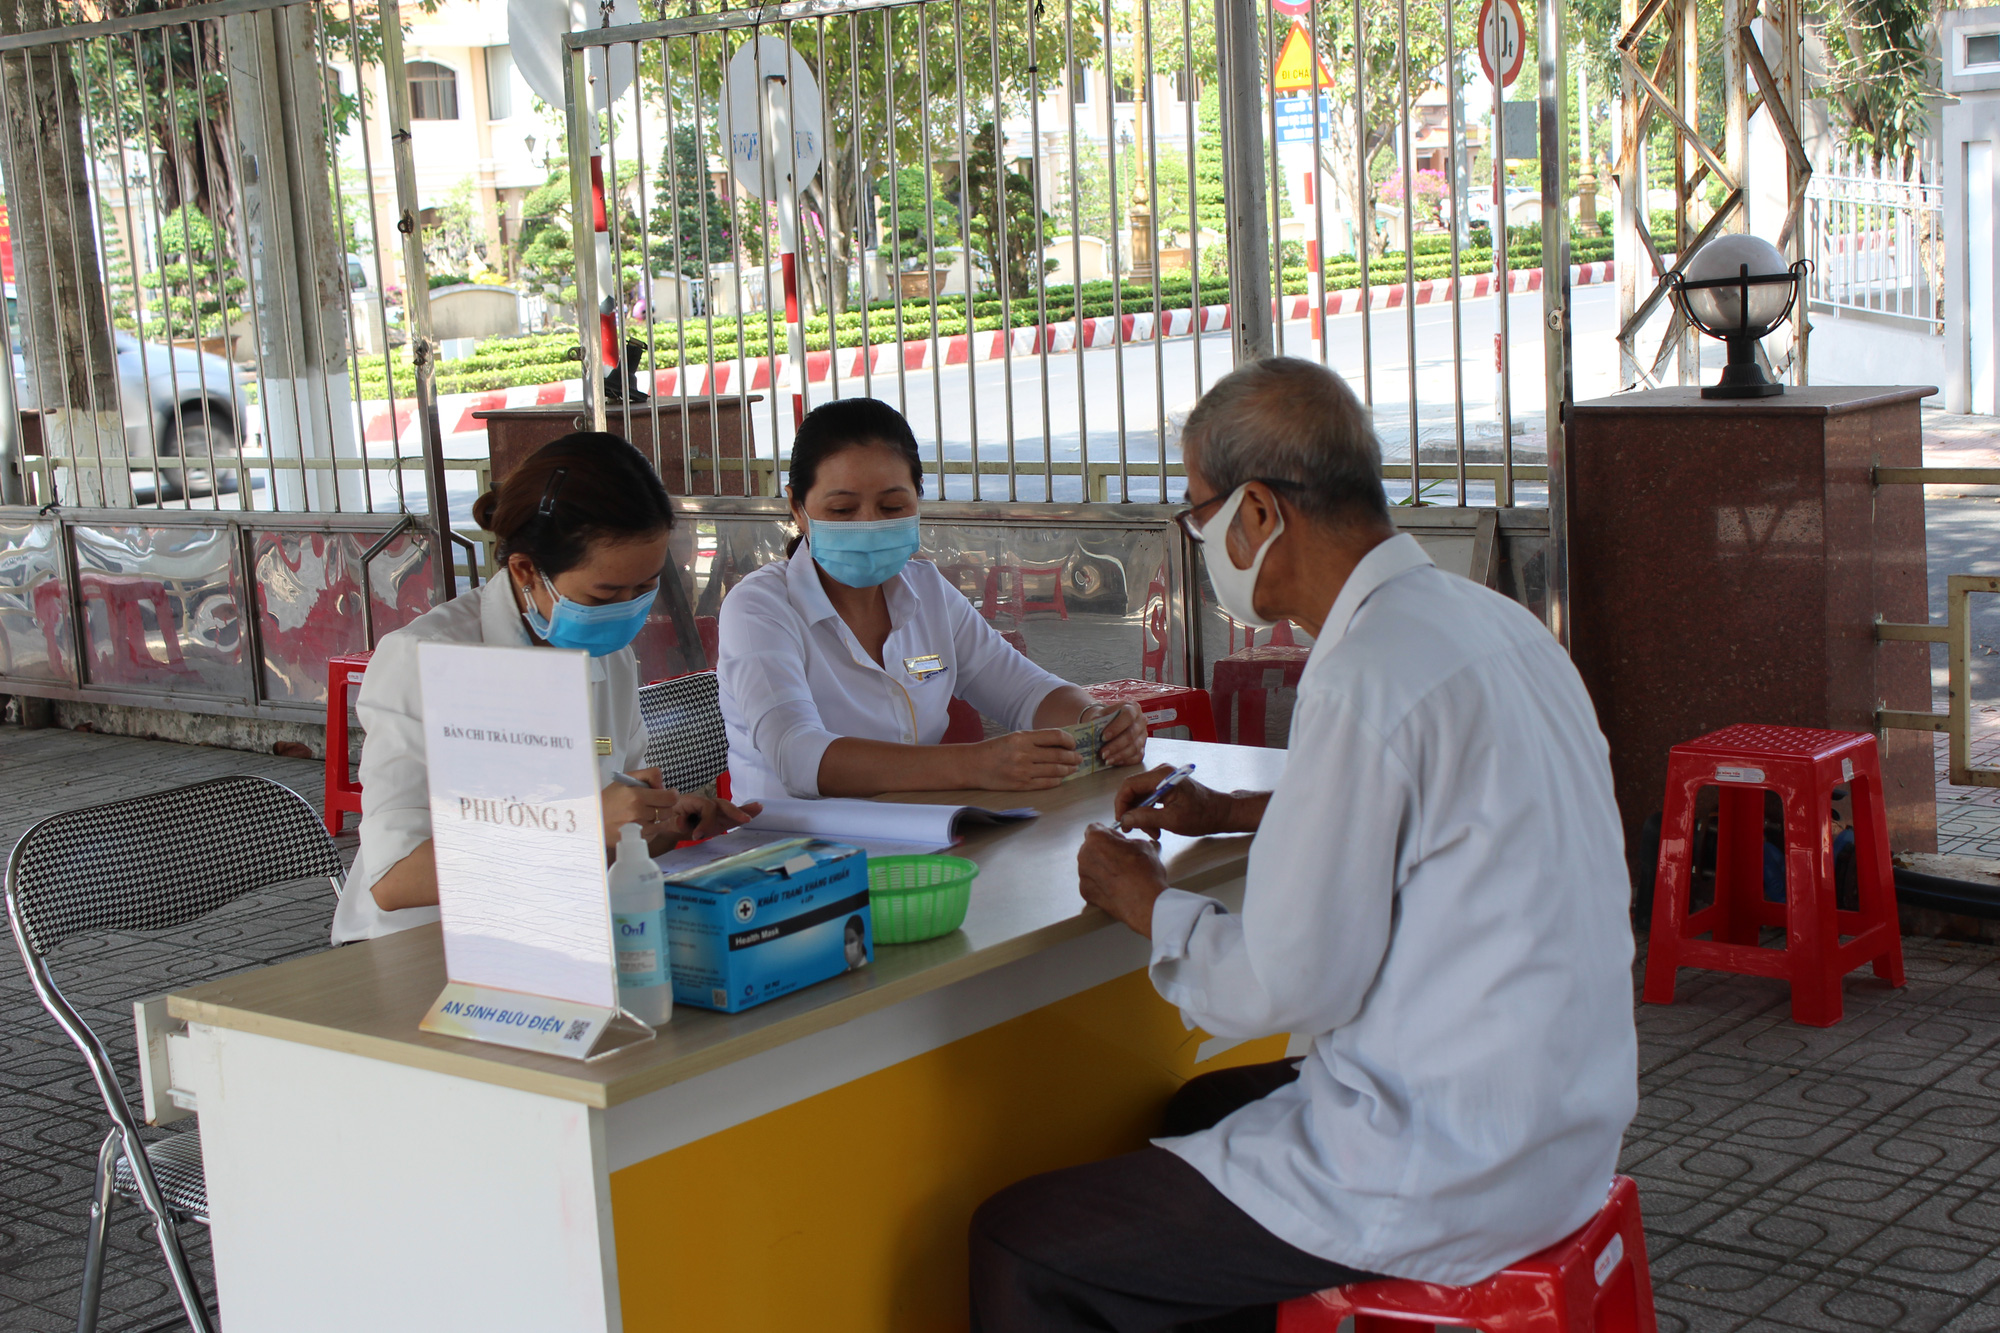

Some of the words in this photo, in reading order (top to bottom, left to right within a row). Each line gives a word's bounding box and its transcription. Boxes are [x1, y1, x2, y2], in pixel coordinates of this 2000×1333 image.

[1282, 70, 1290, 80] ĐI
[443, 724, 464, 739] BÀN
[465, 728, 485, 741] CHI
[486, 728, 508, 743] TRẢ
[510, 732, 548, 748] LƯƠNG
[550, 735, 574, 750] HƯU
[459, 795, 559, 831] PHƯỜNG
[566, 809, 577, 833] 3
[781, 885, 804, 901] TRANG
[621, 921, 646, 937] On1
[735, 932, 761, 947] Health
[761, 927, 780, 940] Mask
[440, 1001, 465, 1016] AN
[462, 1004, 499, 1021] SINH
[496, 1010, 531, 1027] BƯU
[528, 1015, 566, 1035] ĐIỆN
